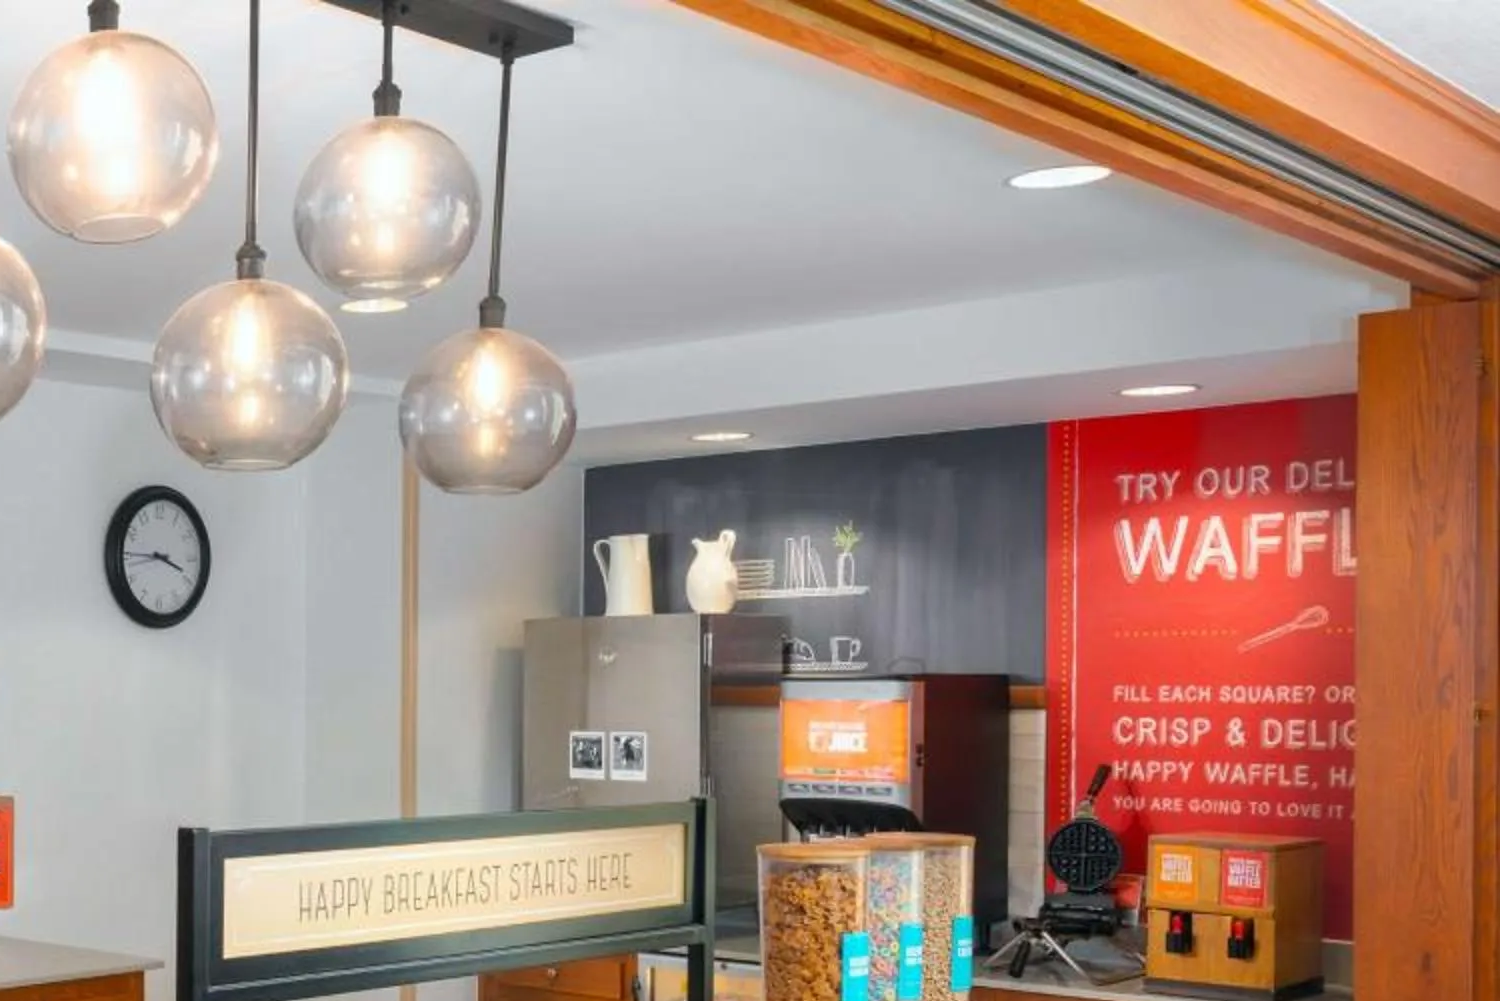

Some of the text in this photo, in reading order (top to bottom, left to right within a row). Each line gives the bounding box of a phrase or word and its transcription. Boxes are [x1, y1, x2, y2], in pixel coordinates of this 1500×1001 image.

[1115, 457, 1356, 503] TRY OUR DEL
[1113, 507, 1358, 585] WAFFL
[1113, 685, 1152, 703] FILL
[1158, 685, 1212, 703] EACH
[1219, 685, 1316, 704] SQUARE?
[1112, 716, 1212, 747] CRISP
[1226, 716, 1247, 747] &
[1112, 760, 1194, 784] HAPPY
[1204, 761, 1318, 790] WAFFLE,
[1113, 796, 1146, 812] YOU
[1150, 797, 1185, 814] ARE
[1188, 799, 1242, 815] GOING
[1250, 801, 1271, 816] TO
[1277, 802, 1322, 818] LOVE
[1328, 804, 1344, 818] IT
[298, 852, 633, 923] HAPPY BREAKFAST STARTS HERE
